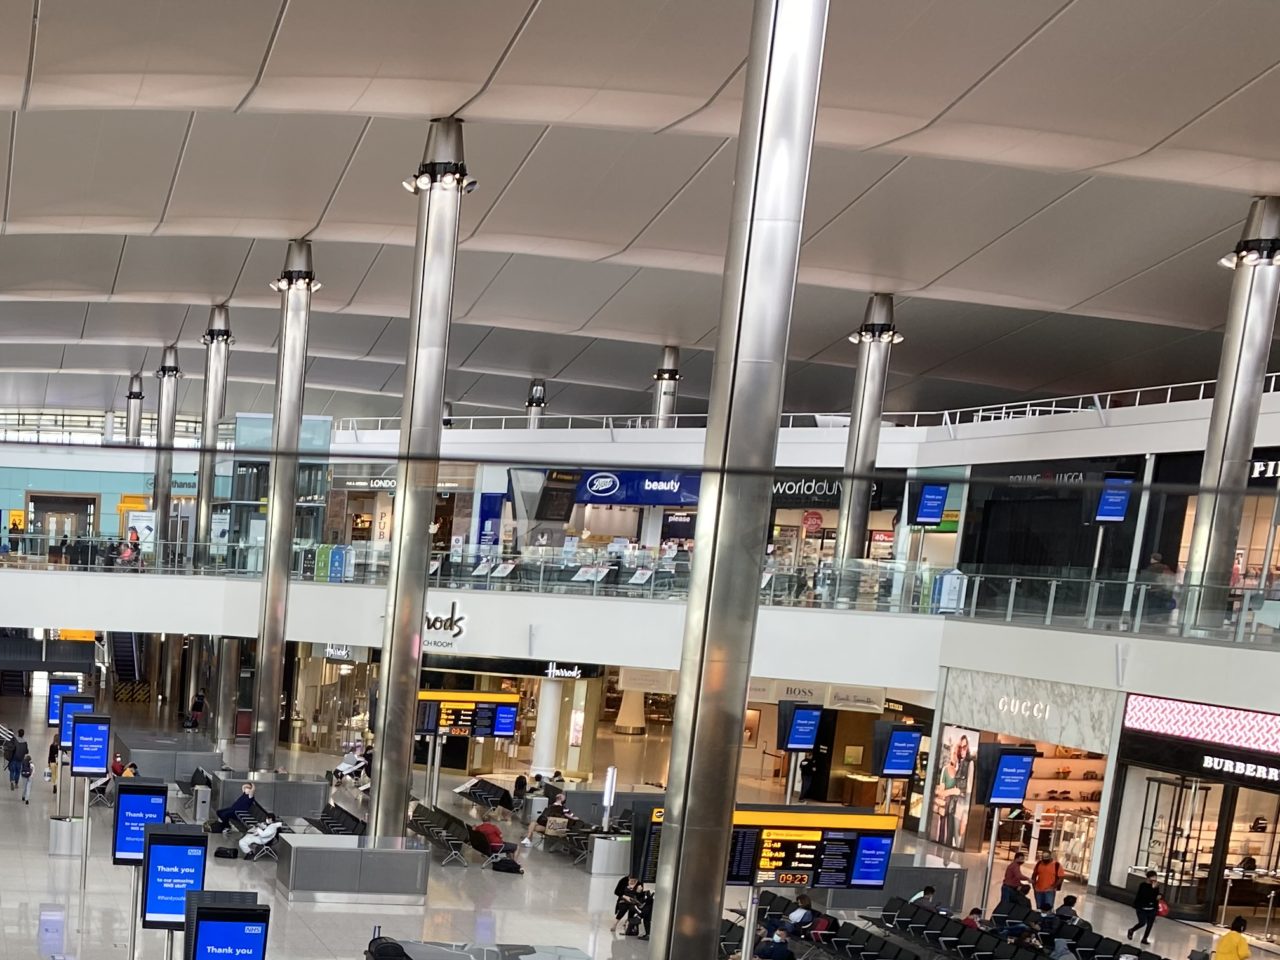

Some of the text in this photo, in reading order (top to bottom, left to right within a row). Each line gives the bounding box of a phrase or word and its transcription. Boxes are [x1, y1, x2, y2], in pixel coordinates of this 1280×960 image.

[370, 479, 397, 488] LONDO
[1055, 472, 1084, 484] LUGGA
[644, 478, 681, 493] beauty
[669, 514, 691, 524] please
[433, 640, 453, 648] ROOM
[545, 661, 582, 679] Harrods
[786, 686, 814, 697] BOSS
[999, 696, 1050, 720] GUCCI
[1203, 755, 1280, 781] BURBERR
[157, 865, 179, 873] Thank
[779, 874, 809, 884] 09:23
[206, 945, 253, 956] Thank you
